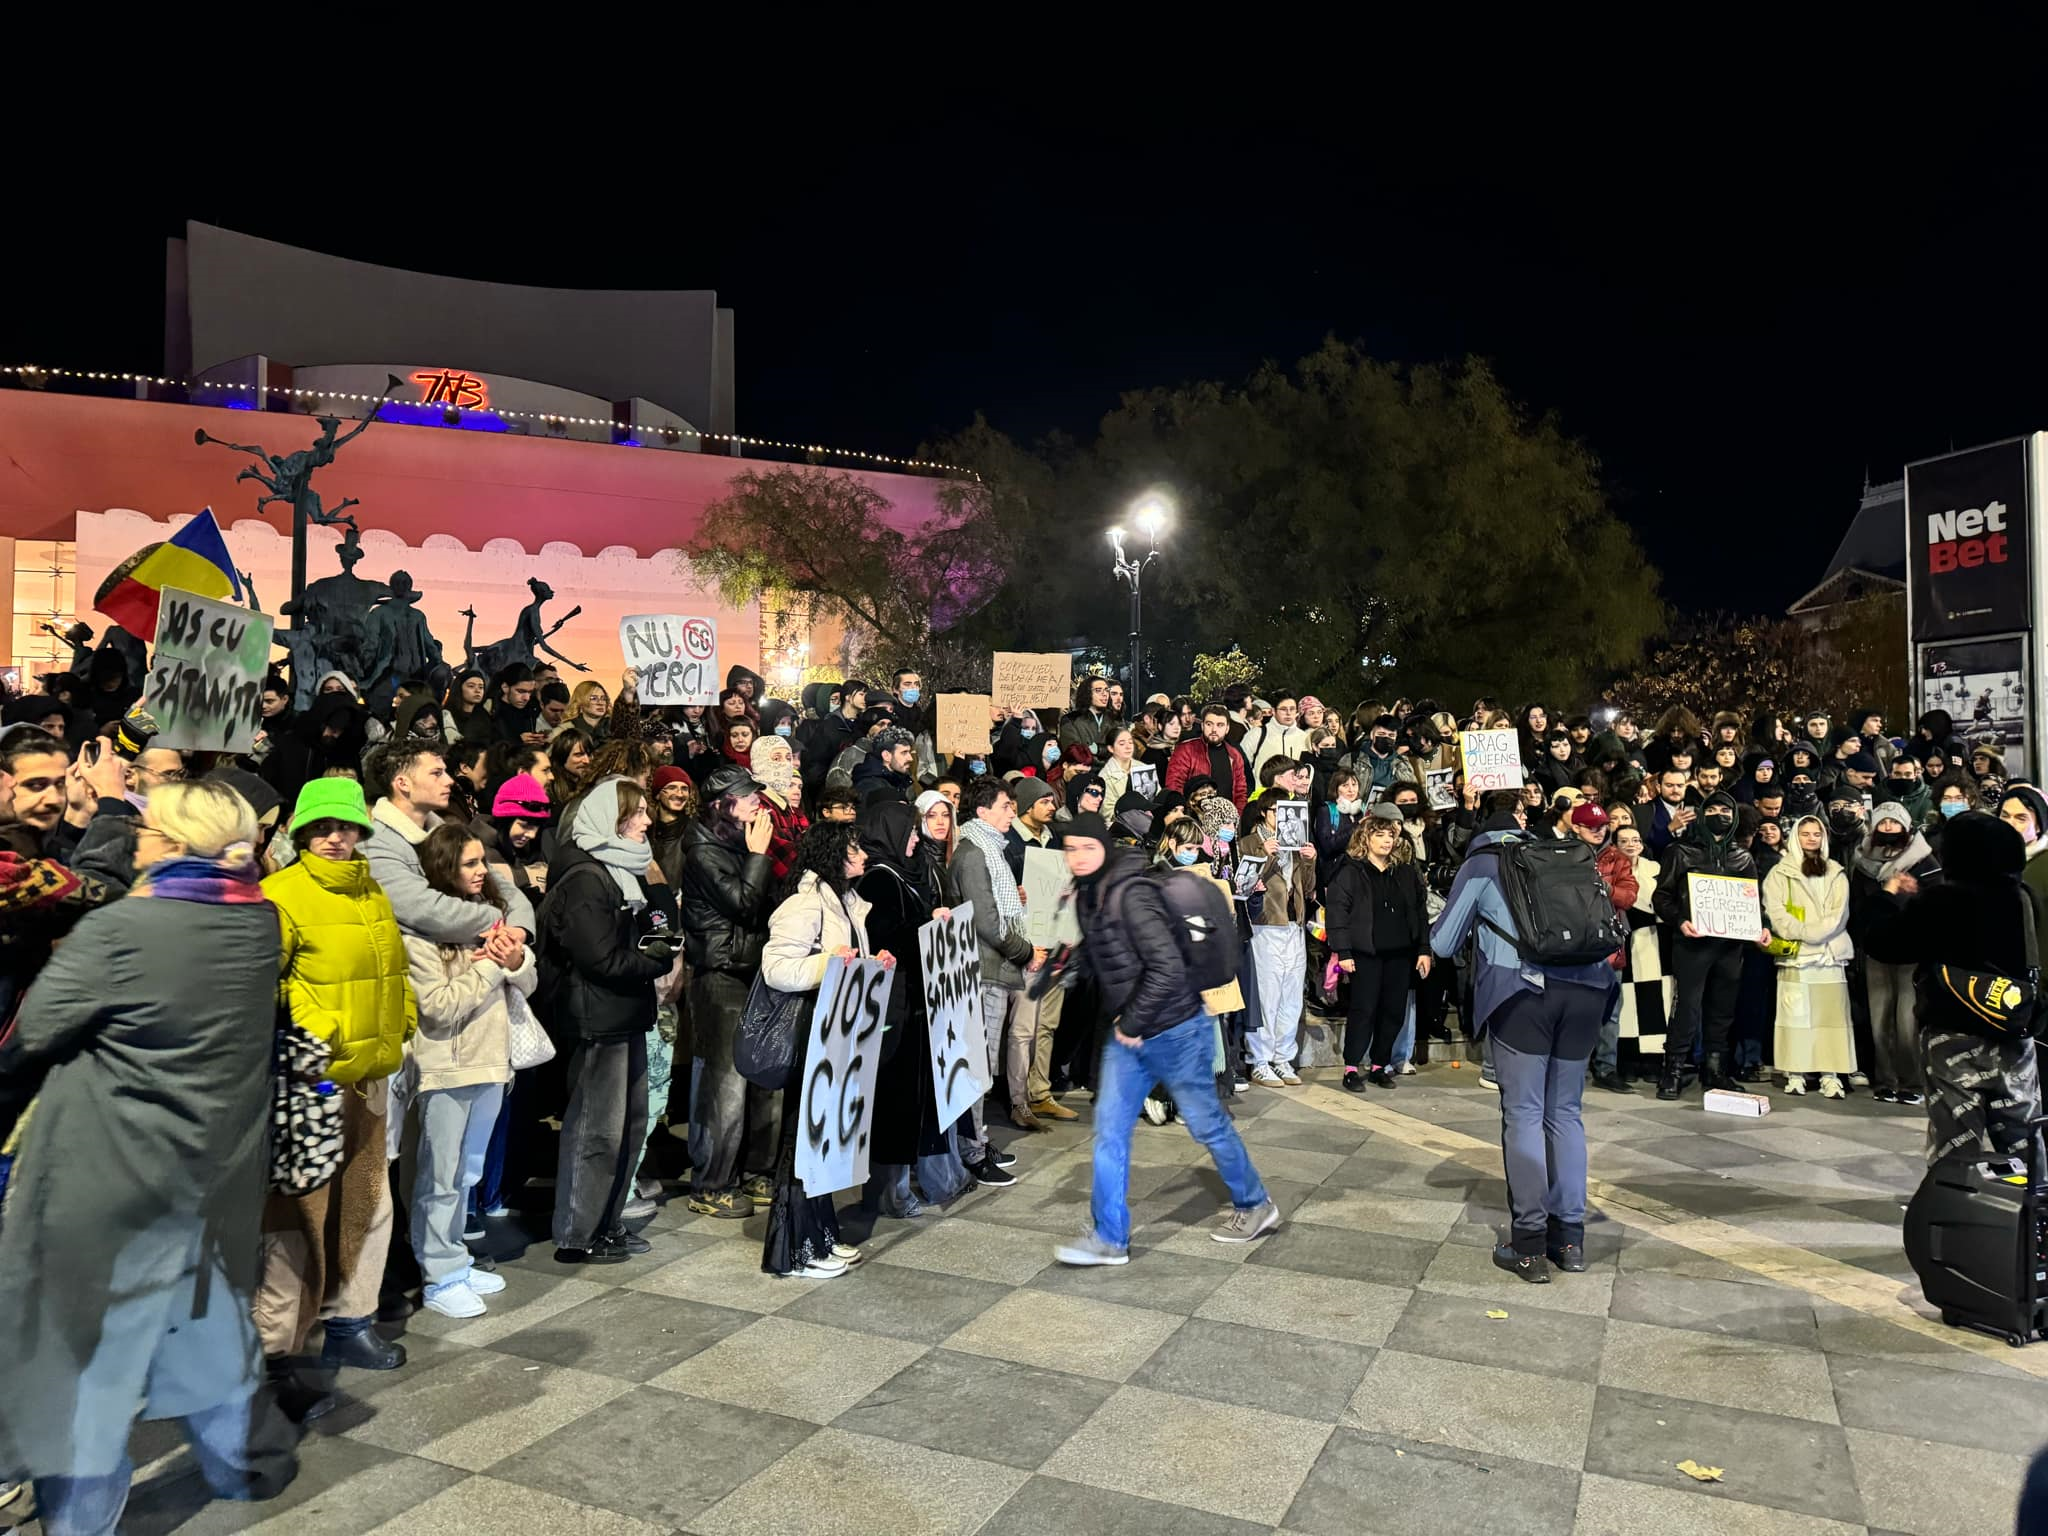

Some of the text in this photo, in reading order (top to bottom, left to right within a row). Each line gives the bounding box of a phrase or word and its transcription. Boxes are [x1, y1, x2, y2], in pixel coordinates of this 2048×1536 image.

[415, 371, 485, 410] TNB
[1928, 500, 2007, 544] Net
[1929, 532, 2008, 575] Bet
[161, 600, 246, 652] JOS CU
[1467, 751, 1519, 768] QUEENS
[1468, 733, 1508, 753] DRAG
[1696, 911, 1728, 935] NU
[926, 916, 977, 975] JOS CU
[820, 963, 886, 1046] JOS
